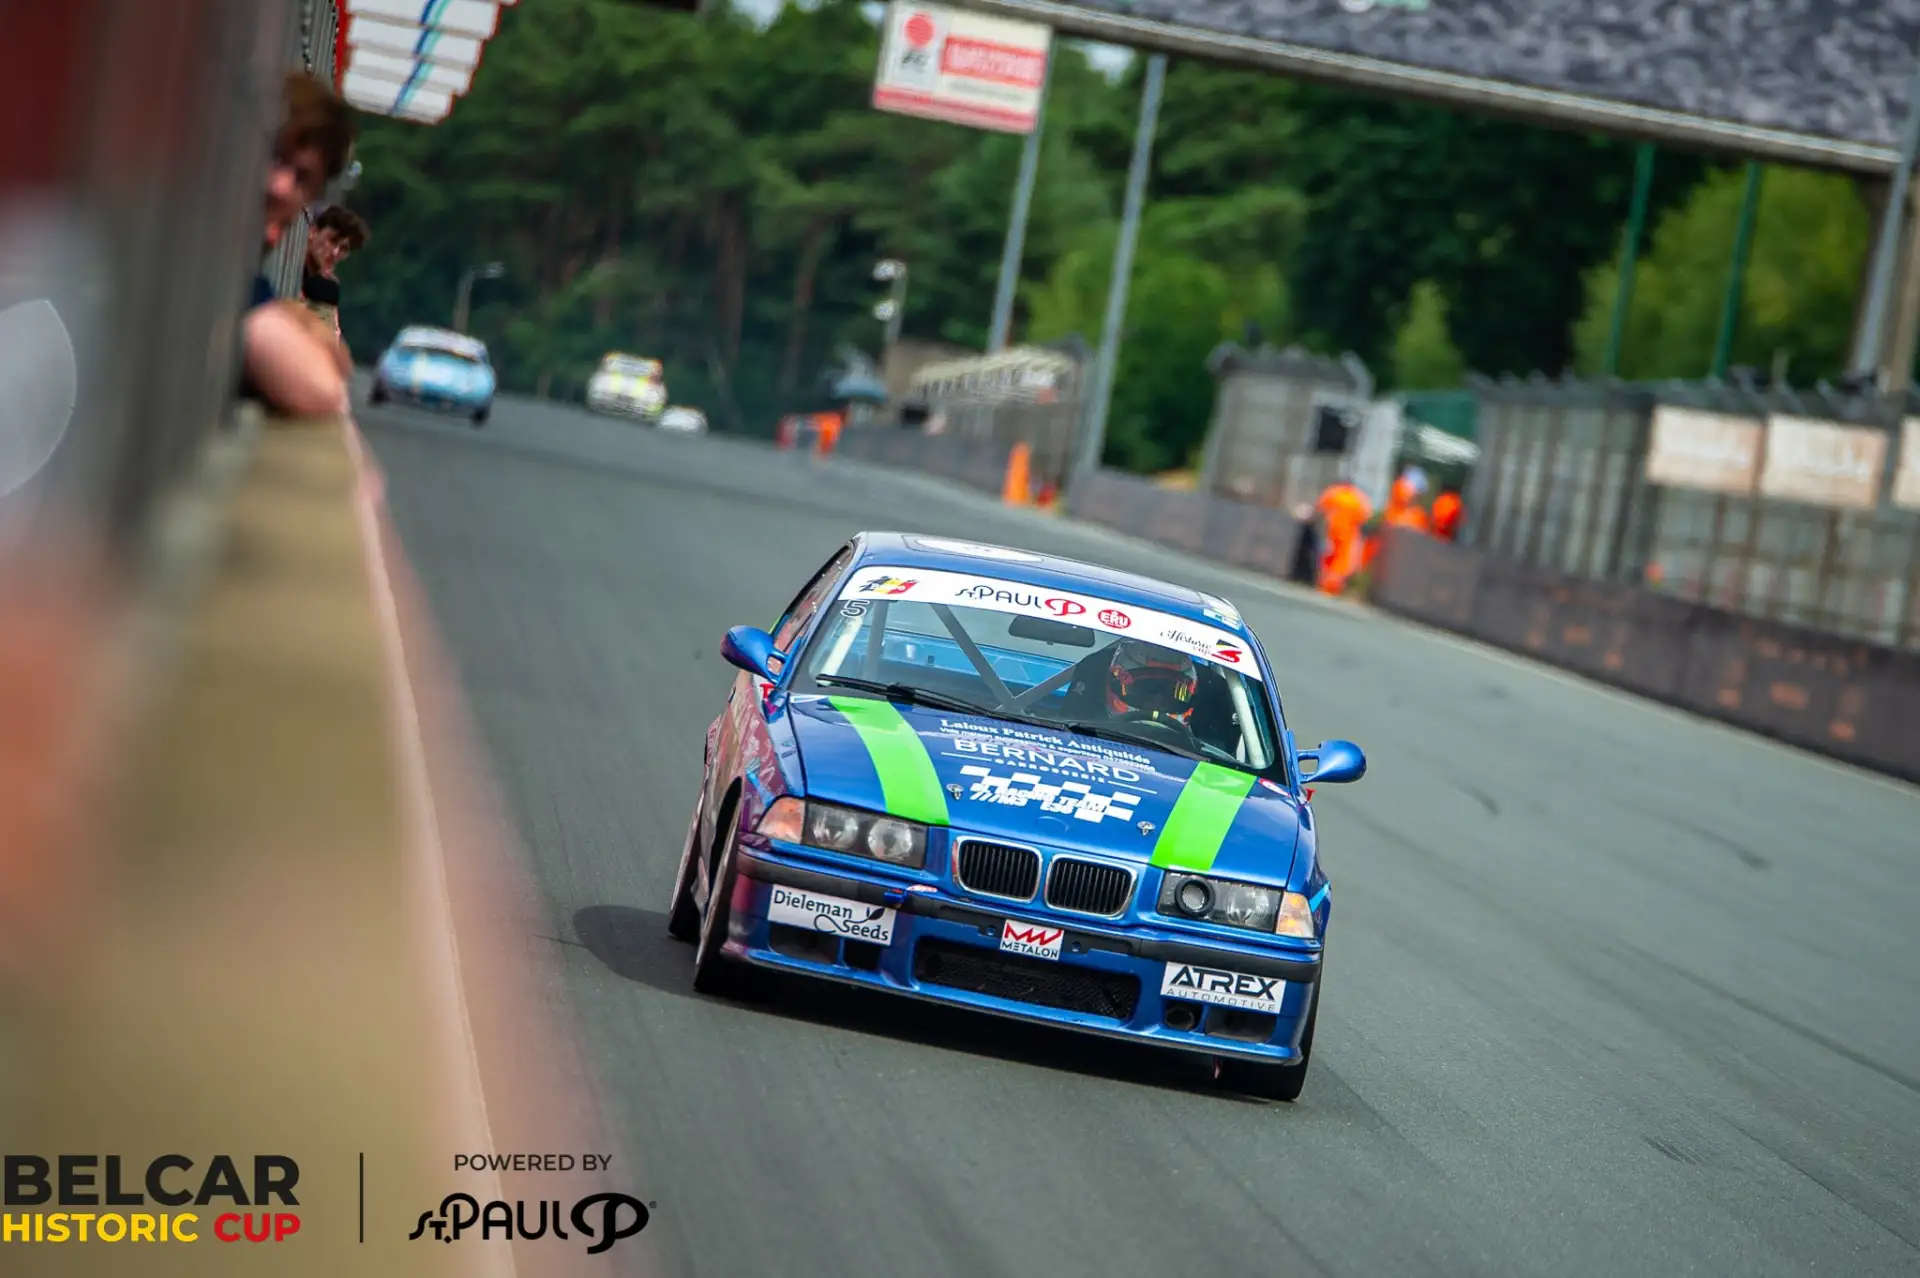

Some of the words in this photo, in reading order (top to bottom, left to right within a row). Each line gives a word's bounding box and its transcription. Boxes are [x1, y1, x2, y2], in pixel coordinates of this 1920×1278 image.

[840, 599, 870, 617] 5
[940, 719, 1000, 734] Laloux
[1002, 728, 1063, 746] Patrick
[954, 738, 1140, 782] BERNARD
[773, 890, 853, 919] Dieleman
[842, 918, 889, 942] Seeds
[1001, 940, 1059, 959] METALON
[1169, 965, 1279, 1001] ATREX
[1166, 988, 1276, 1011] AUTOMOTIVE
